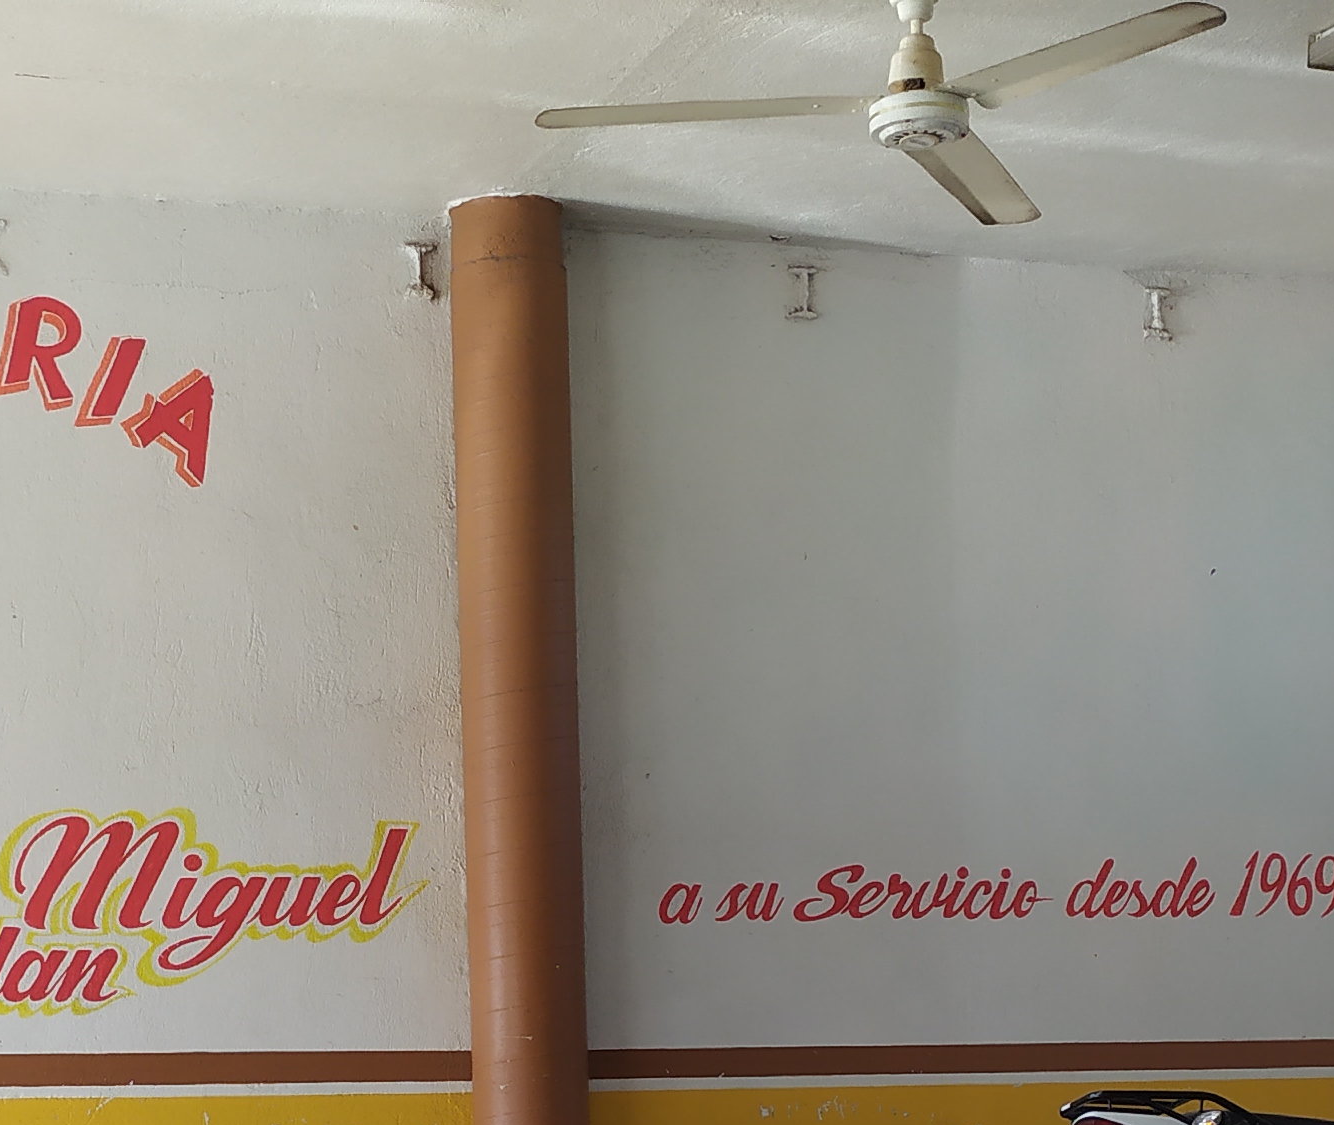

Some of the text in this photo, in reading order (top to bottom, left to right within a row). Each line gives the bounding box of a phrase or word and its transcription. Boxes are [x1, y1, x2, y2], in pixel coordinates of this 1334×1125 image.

[9, 811, 419, 974] Miguel
[658, 882, 703, 925] a
[715, 882, 785, 923] su
[792, 864, 1053, 923] Servicio
[1065, 856, 1216, 920] desde
